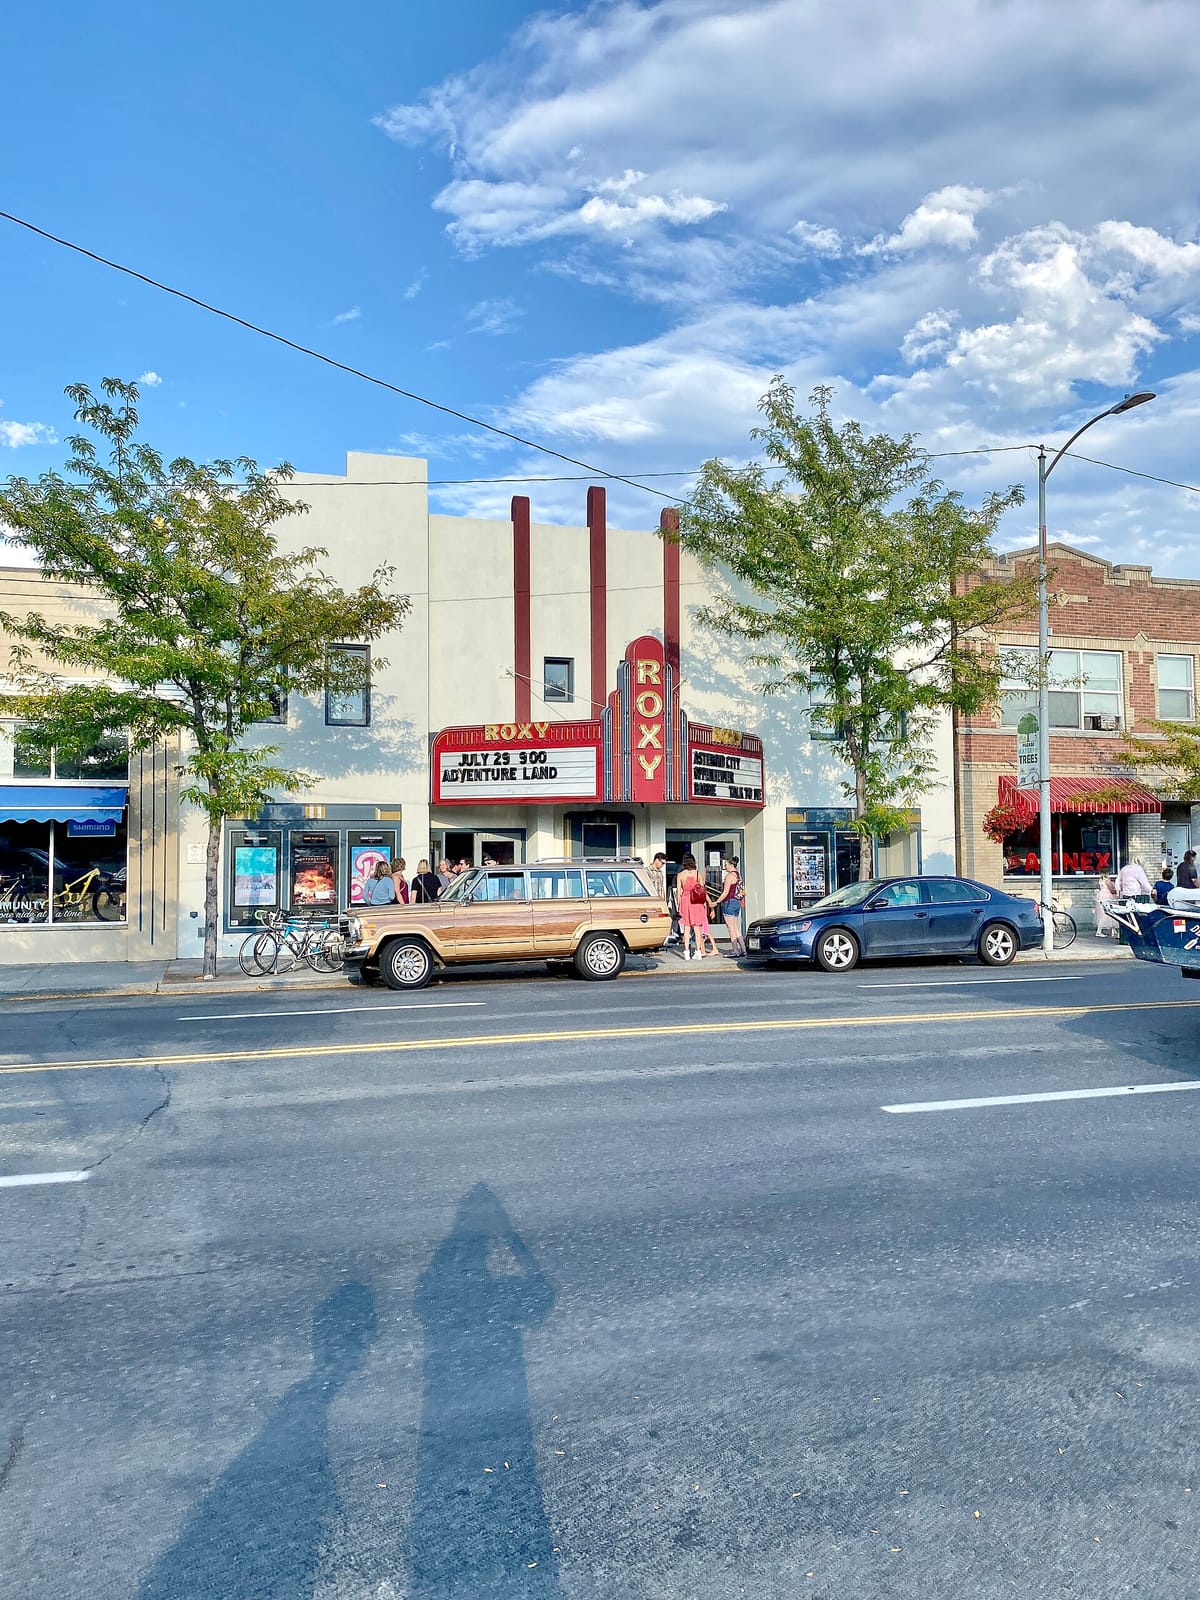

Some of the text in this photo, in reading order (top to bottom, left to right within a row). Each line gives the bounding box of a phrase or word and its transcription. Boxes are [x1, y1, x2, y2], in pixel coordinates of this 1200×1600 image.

[635, 660, 663, 780] ROXY
[484, 722, 549, 741] ROXY
[458, 753, 489, 767] JULY
[493, 752, 510, 766] 29
[726, 756, 741, 770] CITY
[1019, 754, 1037, 764] TREES
[442, 766, 557, 783] ADVENTURE LAND
